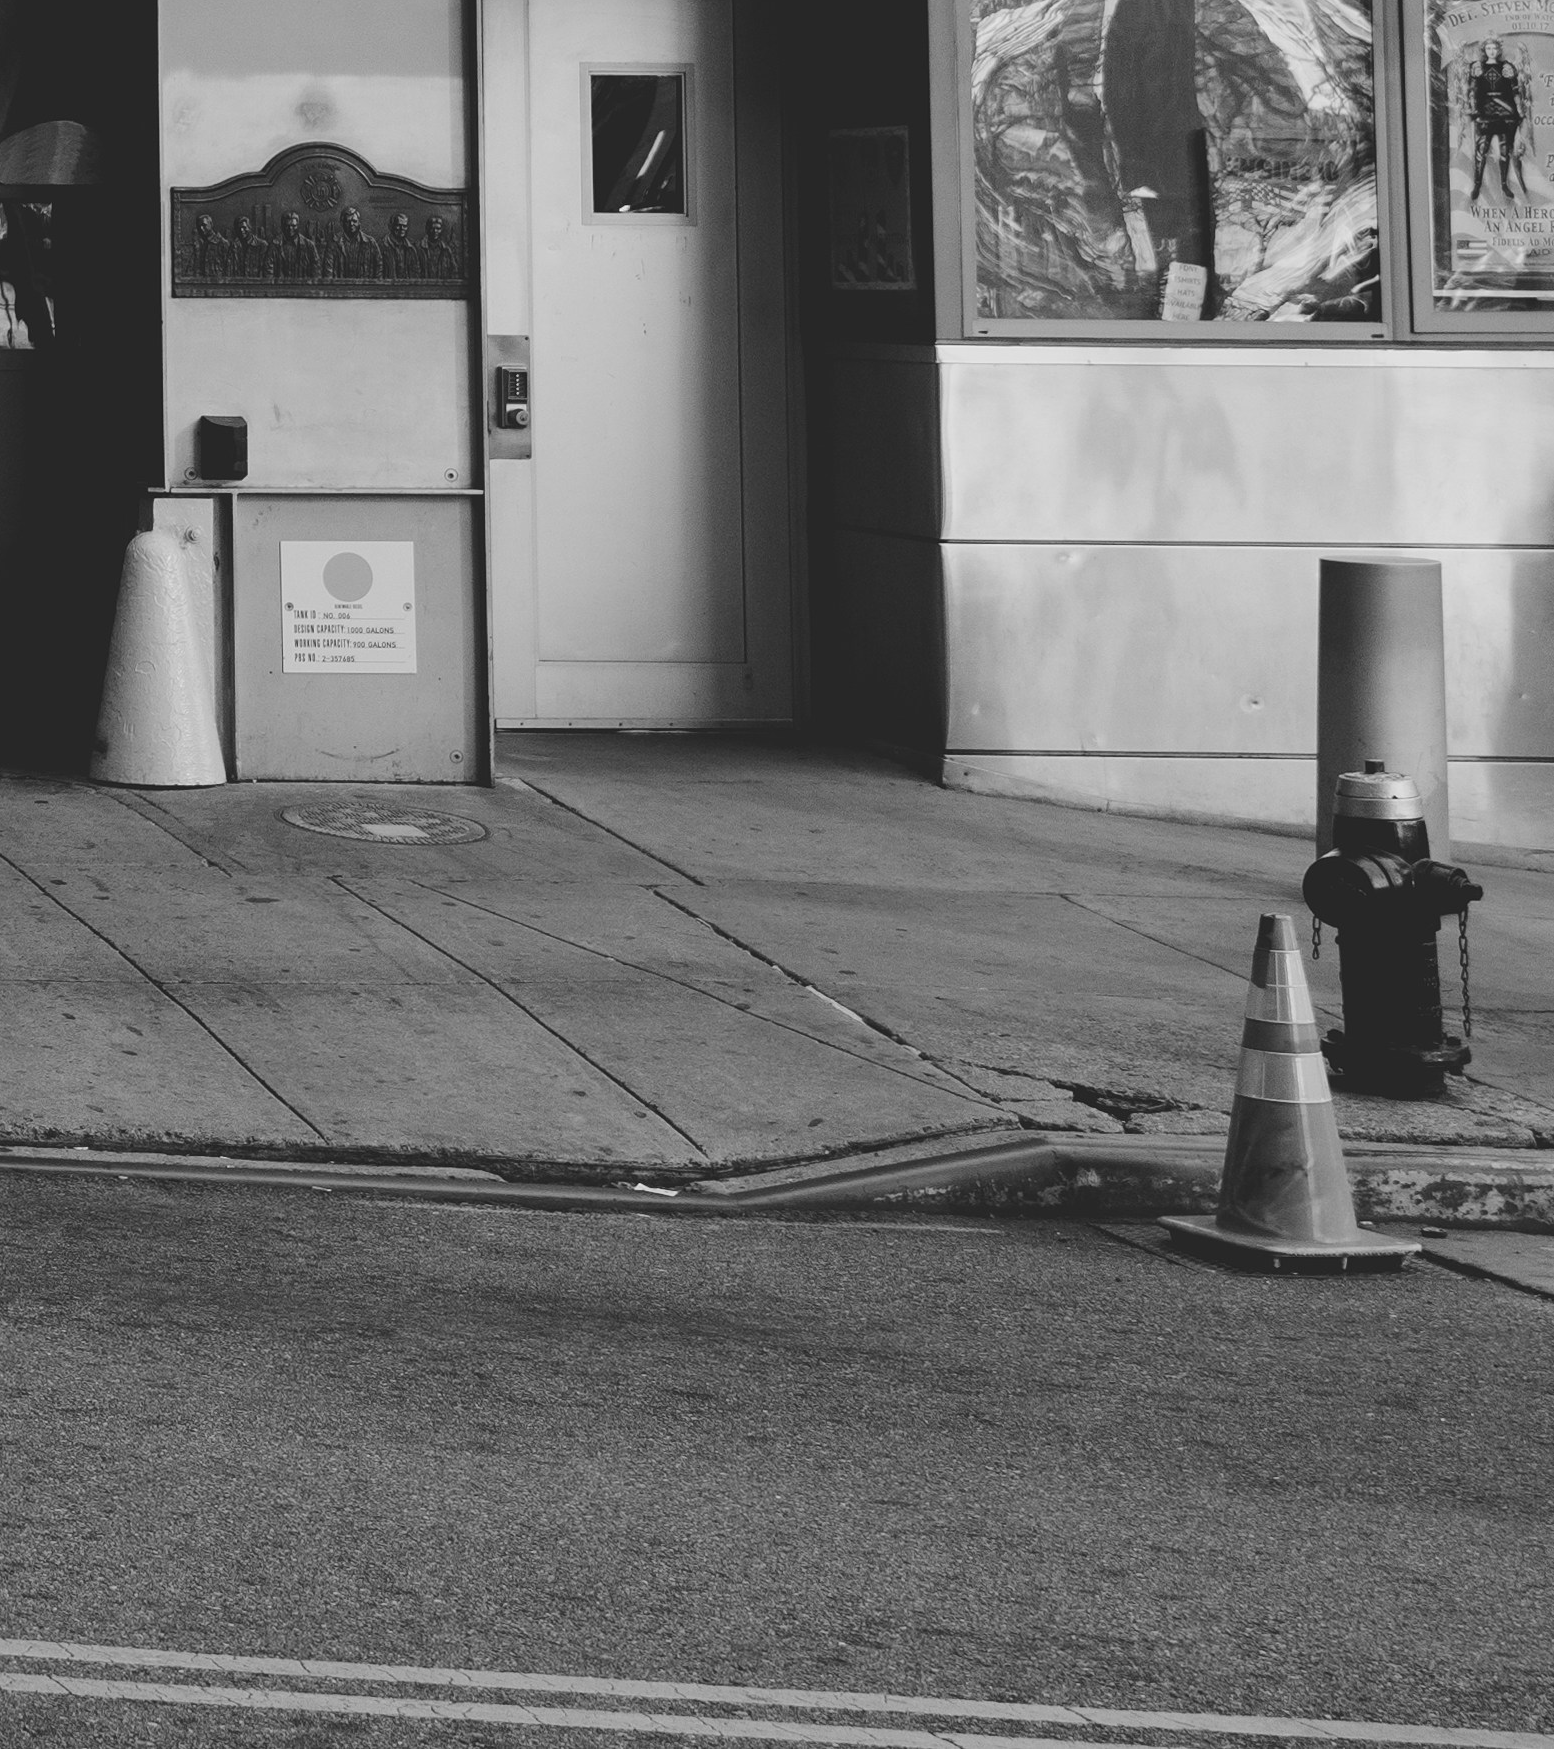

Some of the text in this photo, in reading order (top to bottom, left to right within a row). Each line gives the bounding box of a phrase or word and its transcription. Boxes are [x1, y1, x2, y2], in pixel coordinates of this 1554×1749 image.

[1448, 11, 1478, 27] DET.
[1480, 0, 1530, 17] STEVEN
[1470, 205, 1506, 218] WHEN
[1511, 206, 1520, 218] A
[1484, 220, 1500, 232] AN
[1505, 220, 1544, 233] ANGEL
[294, 610, 308, 619] TANK
[294, 624, 315, 633] DESIGN
[294, 639, 321, 648] WORKING
[294, 653, 306, 662] PBS
